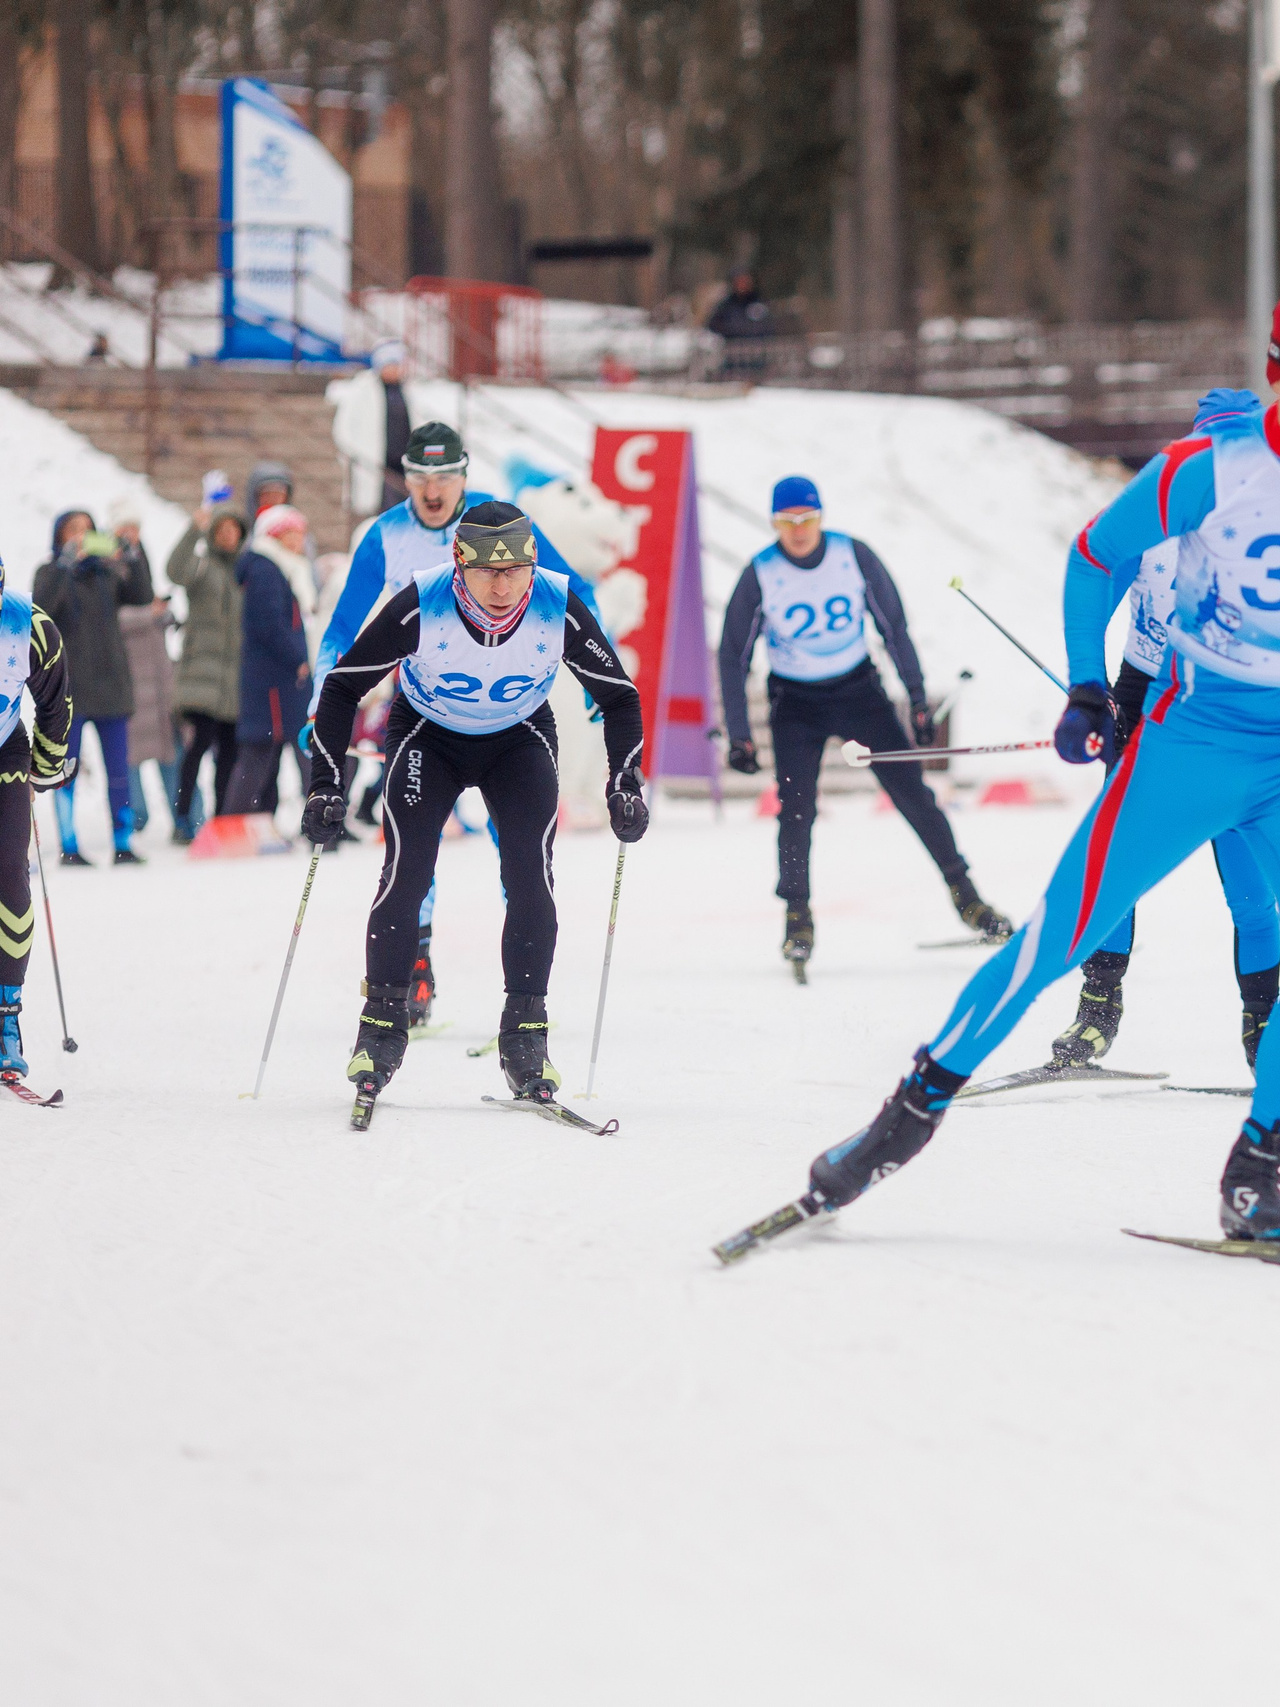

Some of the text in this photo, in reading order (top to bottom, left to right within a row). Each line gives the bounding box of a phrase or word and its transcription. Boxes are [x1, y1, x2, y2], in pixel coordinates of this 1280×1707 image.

[785, 595, 852, 638] 28
[585, 638, 609, 662] CRAFT
[433, 672, 536, 703] 26
[406, 749, 422, 793] CRAFT
